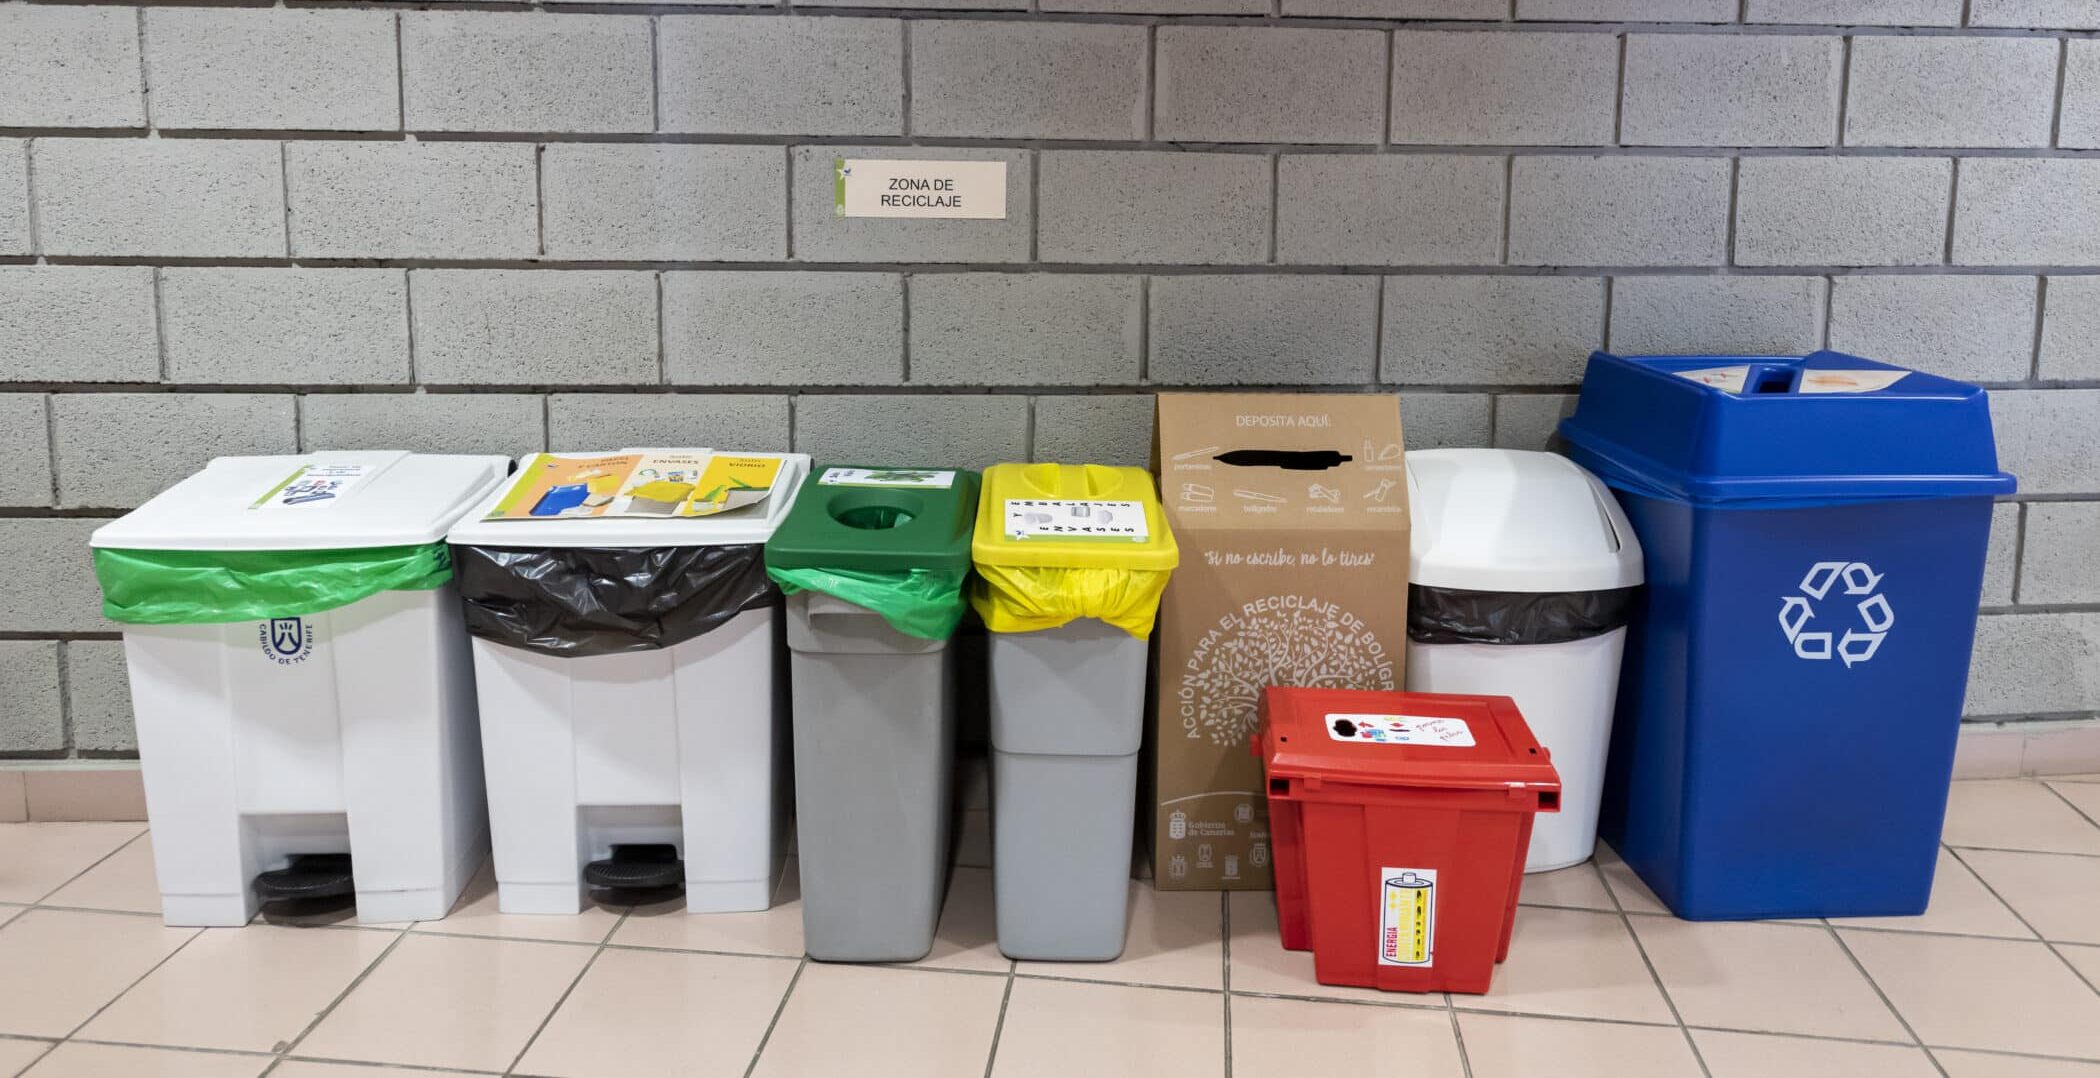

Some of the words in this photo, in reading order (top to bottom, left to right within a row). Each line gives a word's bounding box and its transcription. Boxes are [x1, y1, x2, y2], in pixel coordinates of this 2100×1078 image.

[889, 178, 930, 191] ZONA
[934, 179, 954, 191] DE
[881, 194, 962, 208] RECICLAJE
[1235, 414, 1295, 427] DEPOSITA
[1039, 525, 1135, 533] ENVASES
[1225, 551, 1244, 565] no
[1300, 551, 1319, 566] no
[1321, 547, 1337, 567] lo
[1243, 595, 1341, 618] RECICLAJE
[1219, 612, 1242, 632] EL
[1339, 611, 1366, 635] DE
[259, 623, 277, 660] CABILDO
[278, 657, 291, 665] DE
[292, 624, 313, 664] TENERIFE
[1187, 628, 1223, 672] PARA
[1359, 631, 1395, 692] BOLÍGR
[1178, 674, 1201, 739] ACCIÓN
